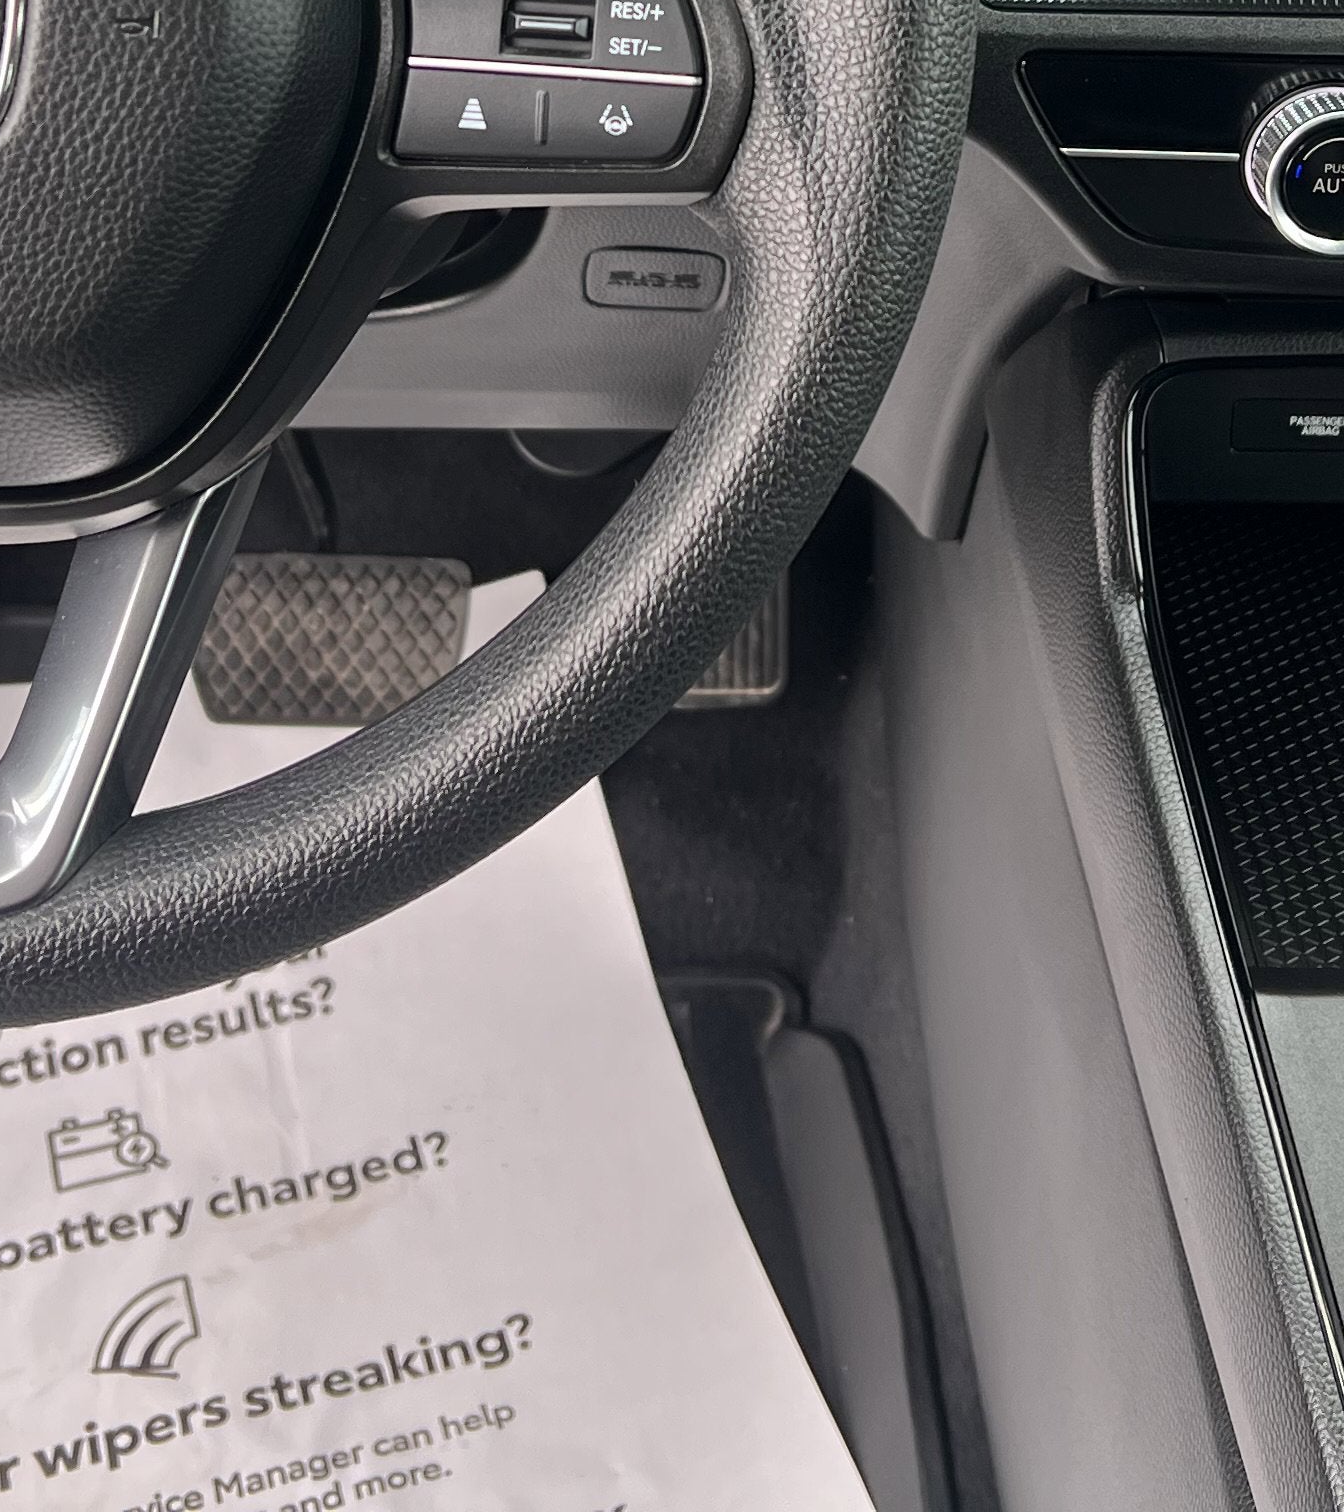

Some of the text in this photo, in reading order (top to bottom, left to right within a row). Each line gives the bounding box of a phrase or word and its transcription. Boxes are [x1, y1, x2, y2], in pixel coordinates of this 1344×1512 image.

[610, 1, 665, 22] RES/+
[1300, 425, 1341, 437] AIRBAG
[142, 974, 338, 1058] results?
[207, 1130, 450, 1220] charged?
[33, 1394, 230, 1472] wipers
[240, 1311, 534, 1420] streaking?
[210, 1442, 364, 1505] Manager
[373, 1426, 434, 1457] can
[440, 1402, 518, 1442] help
[355, 1458, 454, 1503] more.
